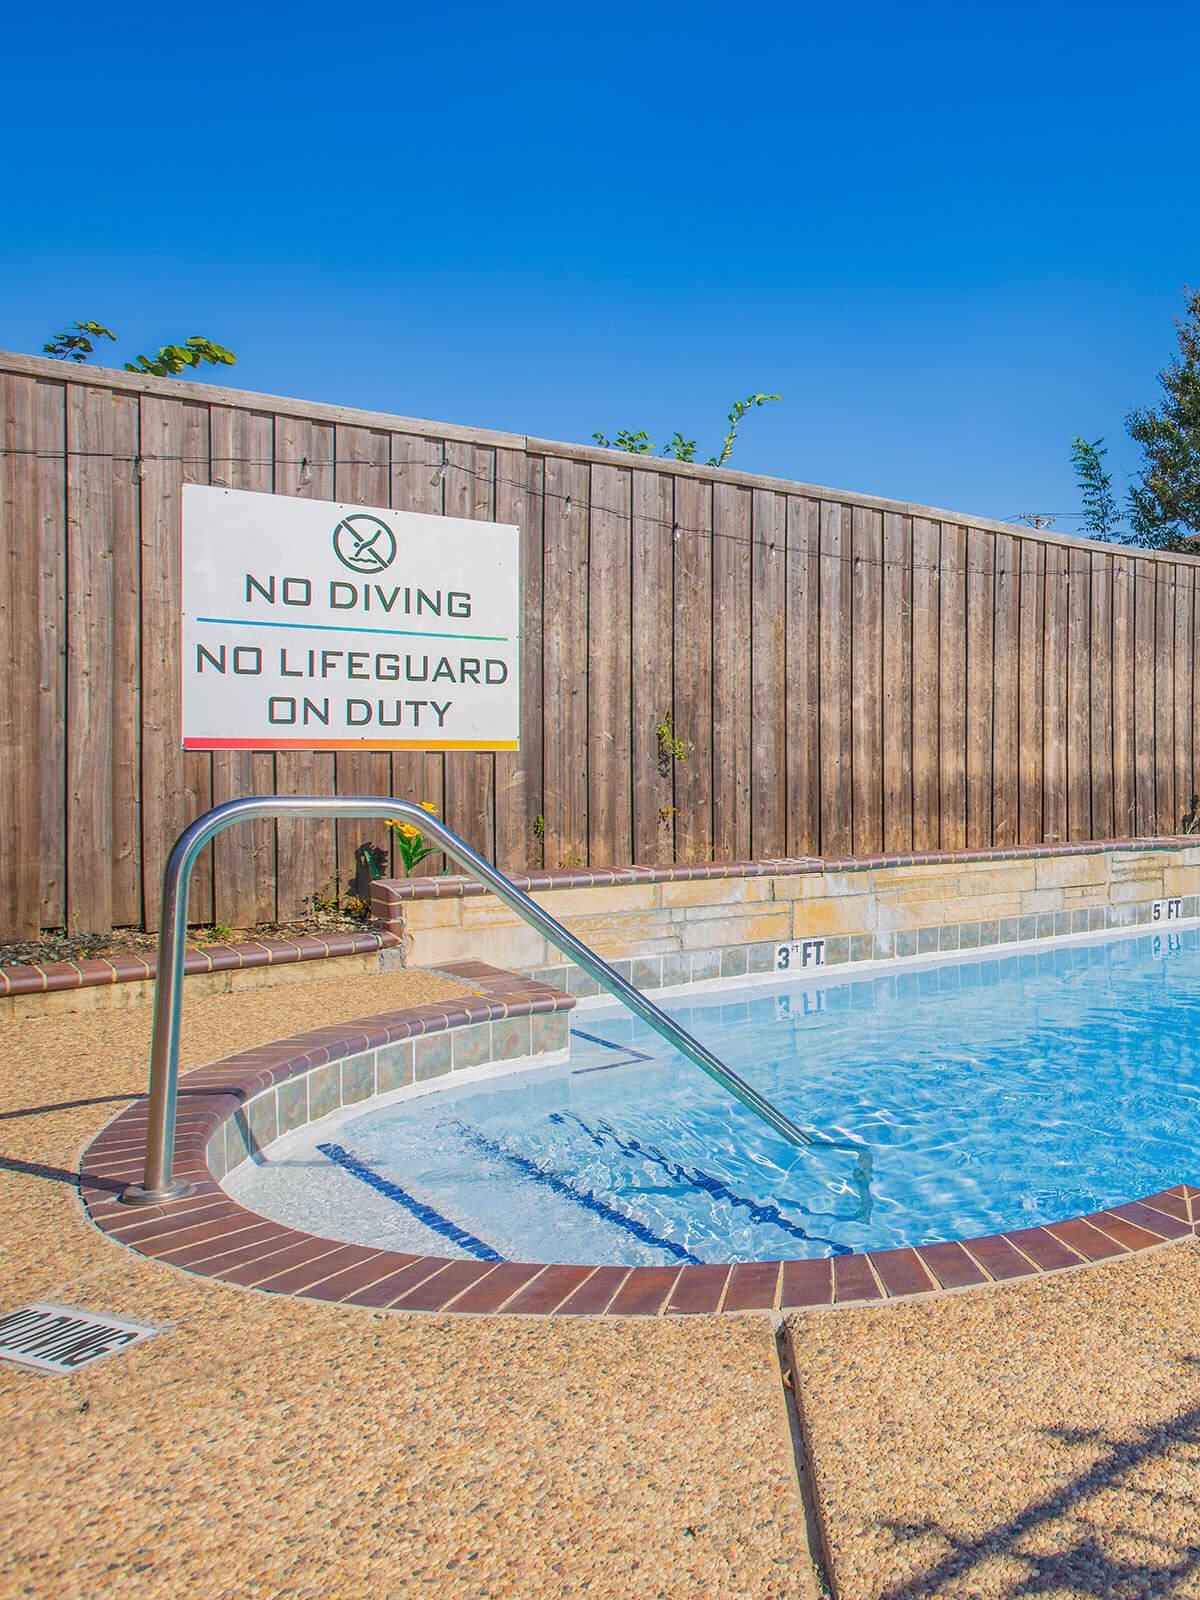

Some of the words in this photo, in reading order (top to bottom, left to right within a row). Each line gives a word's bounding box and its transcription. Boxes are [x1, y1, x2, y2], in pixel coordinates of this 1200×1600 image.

[245, 573, 312, 607] NO
[329, 580, 472, 619] DIVING
[196, 643, 262, 675] NO
[280, 649, 508, 685] LIFEGUARD
[268, 696, 329, 726] ON
[346, 698, 453, 727] DUTY
[1153, 903, 1161, 920] 5
[1168, 900, 1181, 919] FT
[777, 947, 790, 969] 3
[0, 1315, 139, 1367] DIVING
